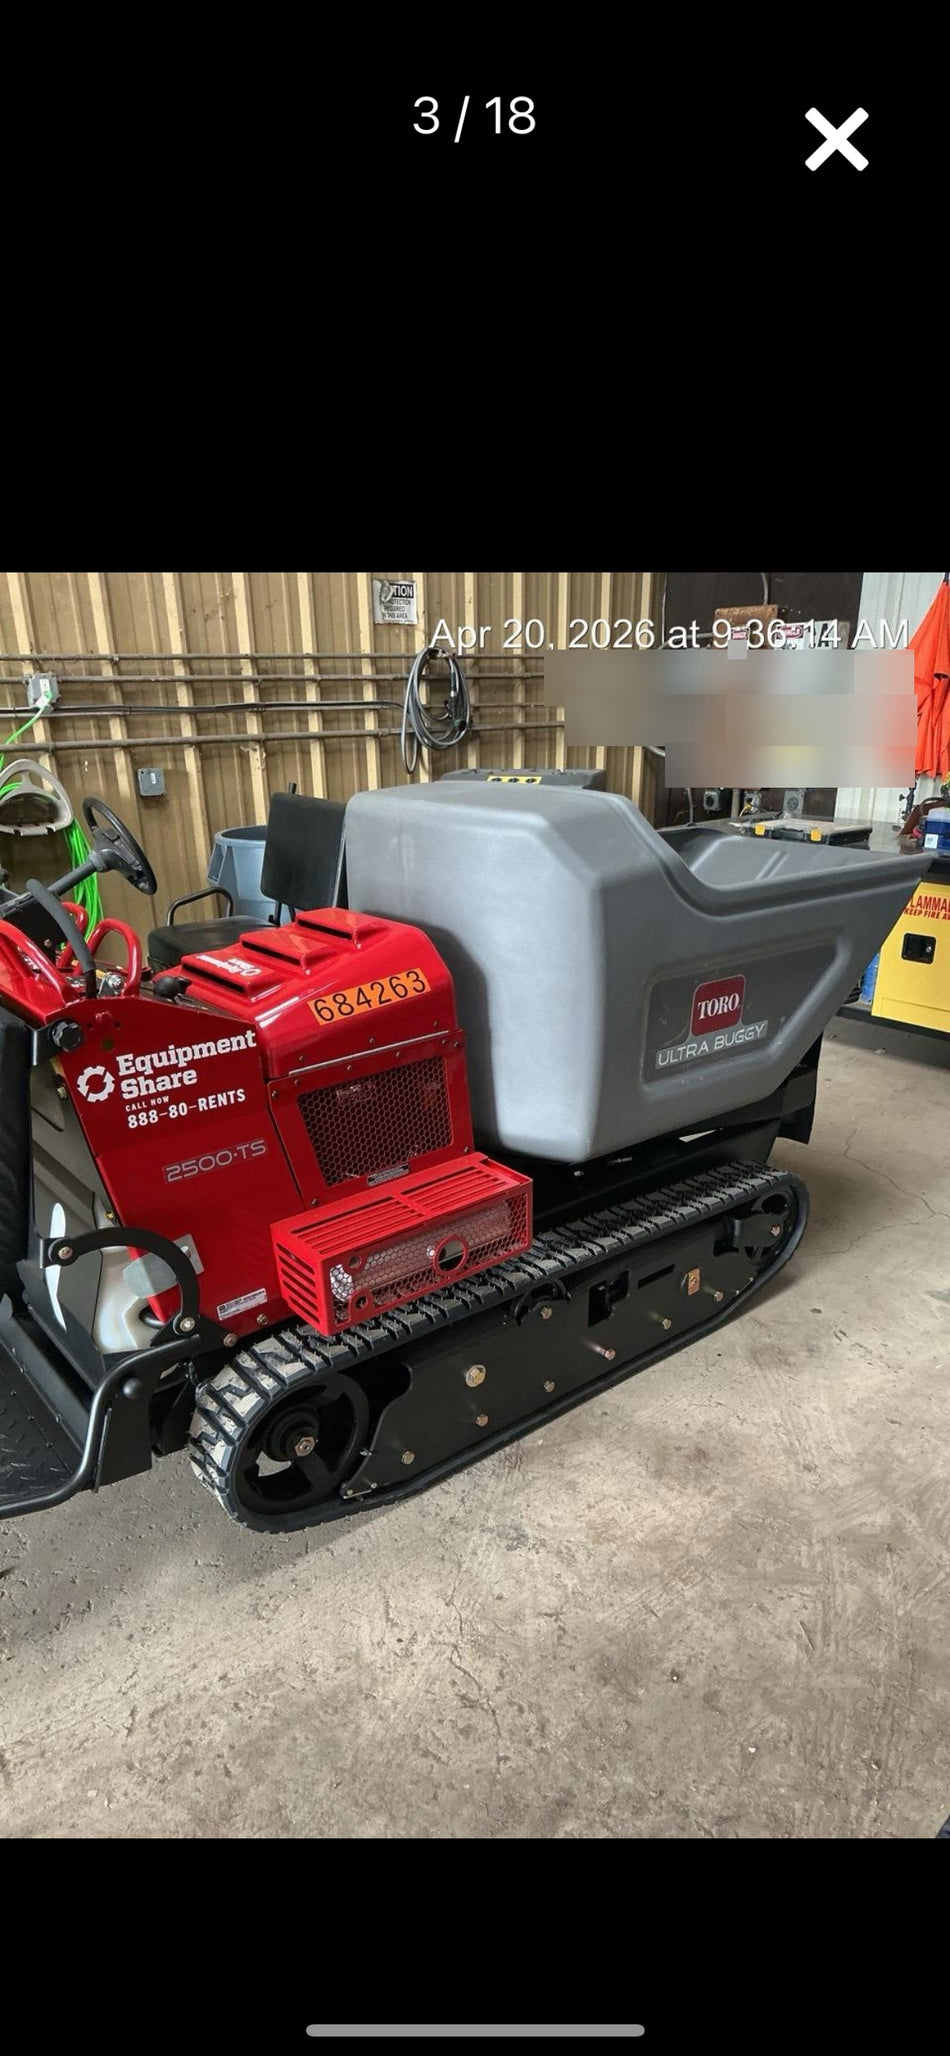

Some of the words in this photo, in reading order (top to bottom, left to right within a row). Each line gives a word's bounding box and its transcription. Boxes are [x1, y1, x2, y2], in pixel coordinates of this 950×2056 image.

[904, 907, 923, 917] KEEP
[923, 910, 940, 919] FIRE
[909, 895, 950, 913] LAMMA
[313, 970, 426, 1022] 684263
[698, 992, 740, 1020] TORO
[116, 1029, 257, 1076] Equipment
[658, 1040, 709, 1066] ULTRA
[714, 1023, 765, 1050] BUGGY
[120, 1069, 198, 1100] Share
[125, 1101, 147, 1112] CALL
[150, 1095, 170, 1107] NOW
[127, 1088, 246, 1129] 888-80-RENTS
